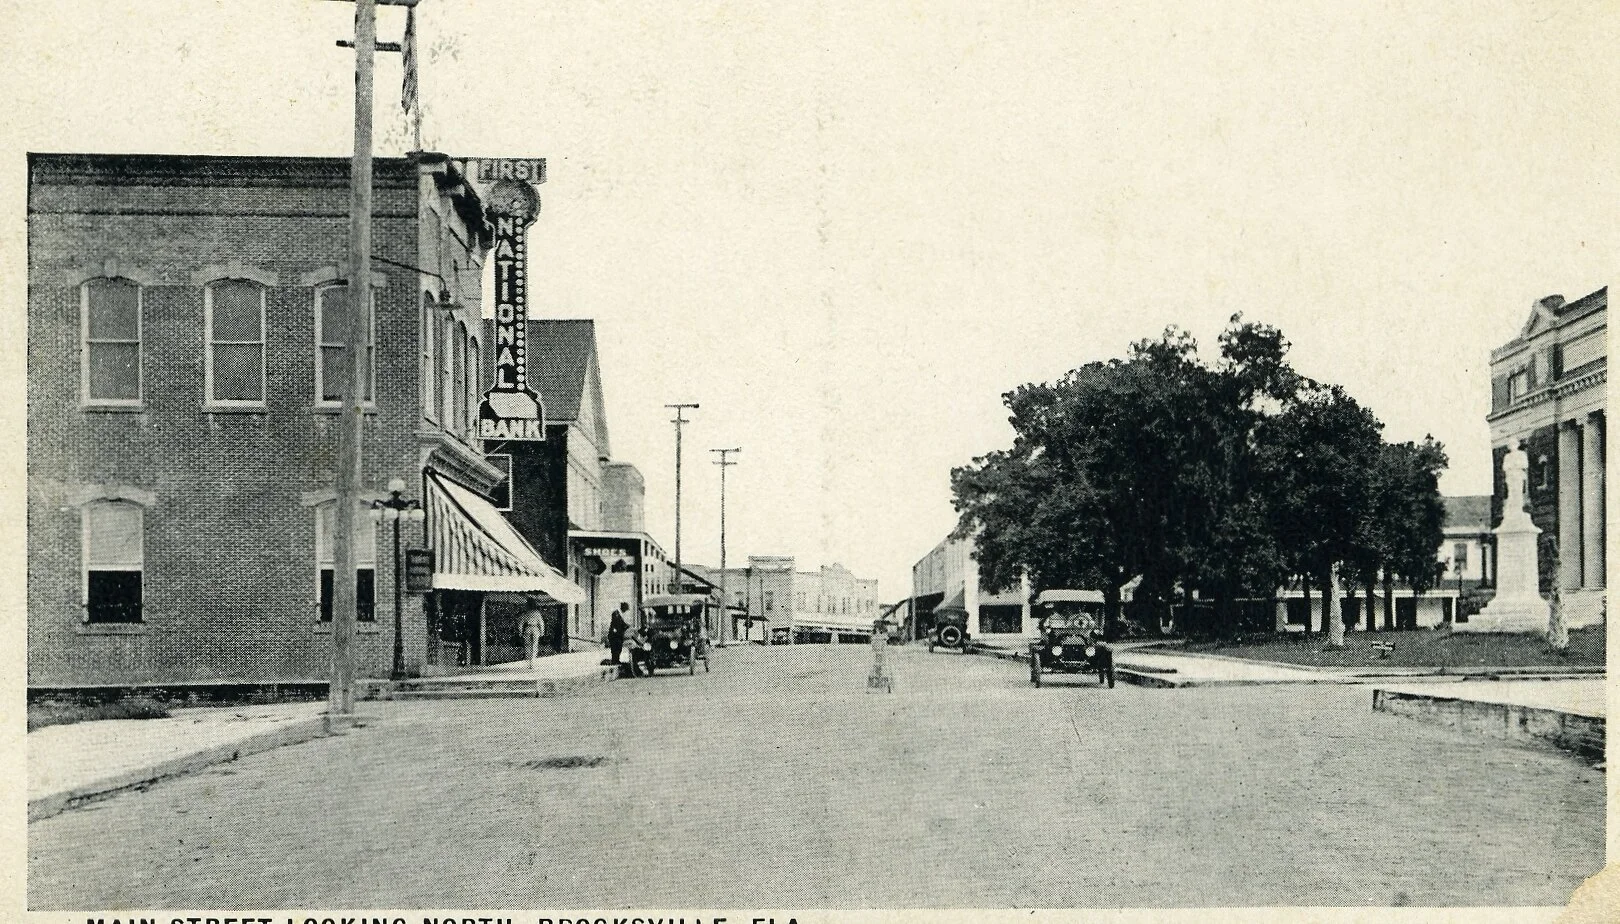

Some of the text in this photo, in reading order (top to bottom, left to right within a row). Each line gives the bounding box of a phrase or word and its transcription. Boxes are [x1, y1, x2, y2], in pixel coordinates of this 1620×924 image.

[479, 159, 541, 181] FIRST
[497, 216, 515, 389] NATIONAL
[480, 419, 541, 438] BANK
